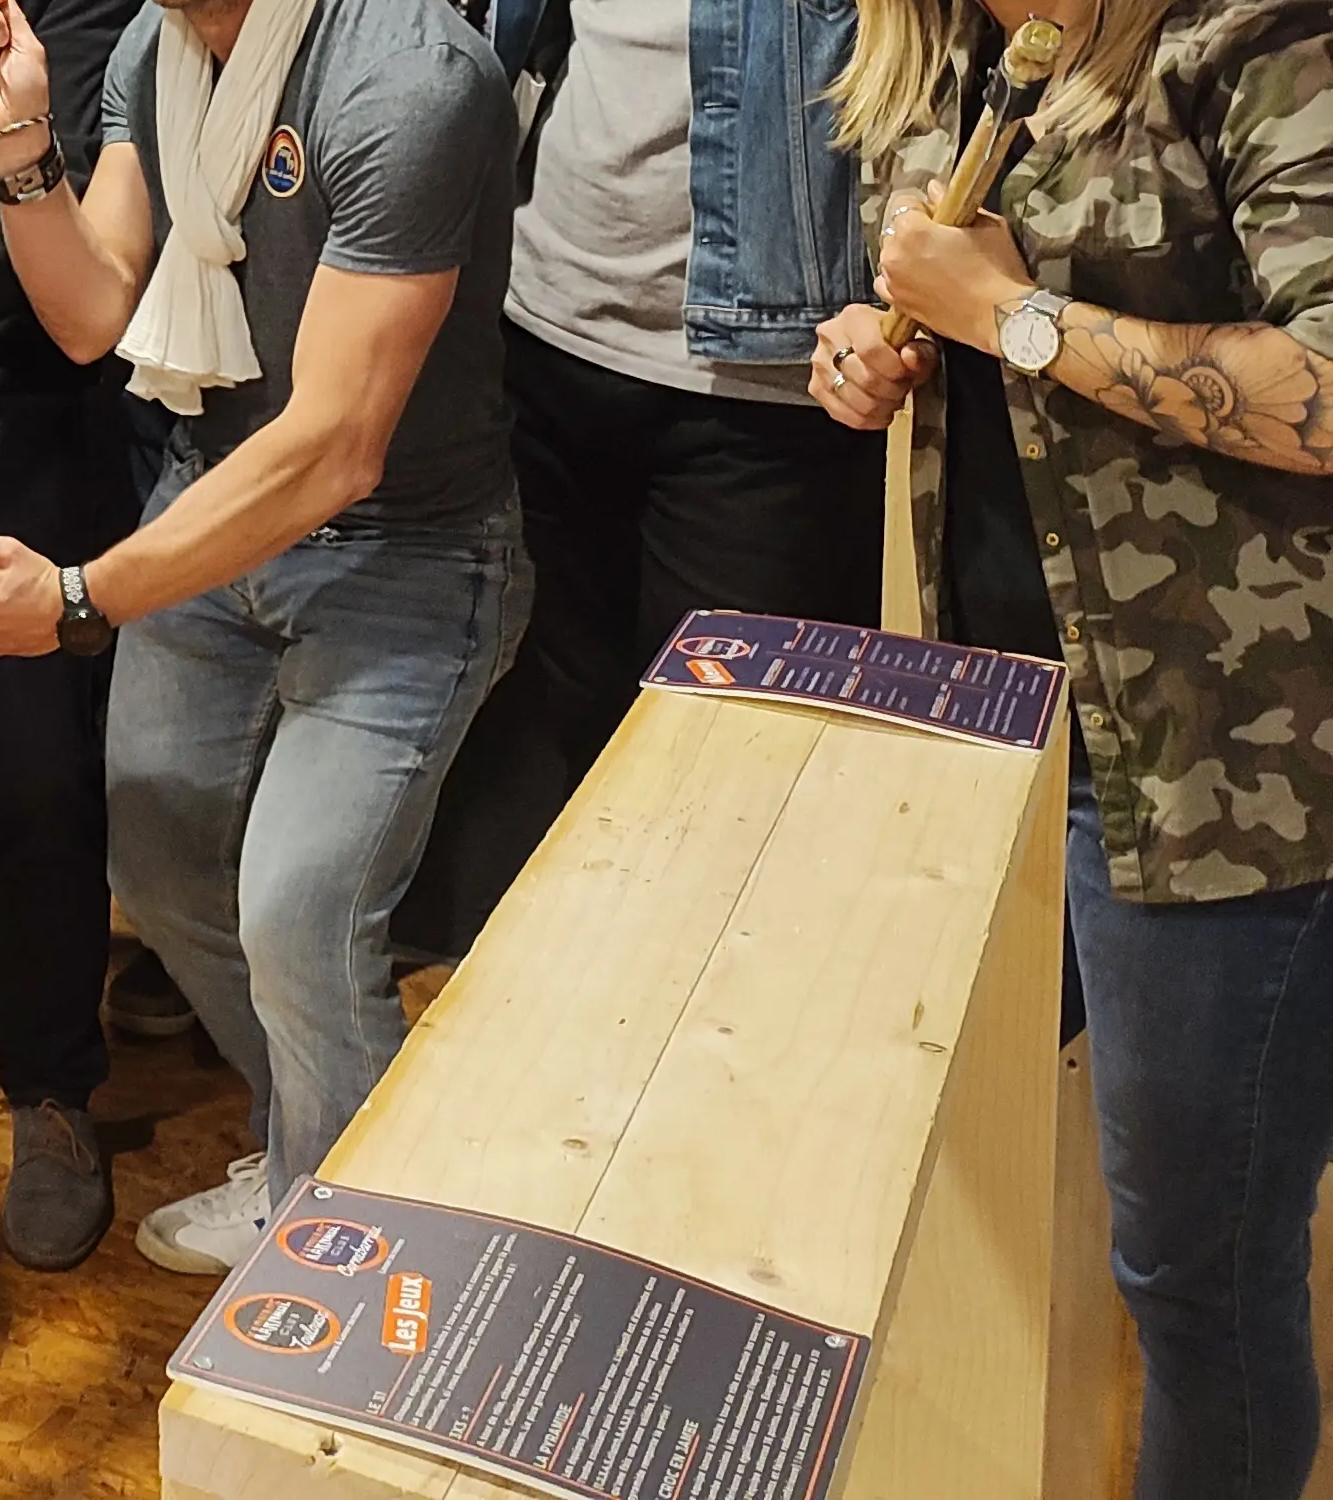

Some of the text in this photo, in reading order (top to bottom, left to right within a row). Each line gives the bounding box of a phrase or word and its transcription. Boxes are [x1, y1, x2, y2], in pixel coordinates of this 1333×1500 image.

[392, 1276, 428, 1323] Jeux
[388, 1318, 418, 1351] Les
[366, 1401, 382, 1415] LE
[533, 1402, 573, 1470] LA PYRAMIDE
[658, 1467, 681, 1499] CROC
[672, 1452, 686, 1469] EN
